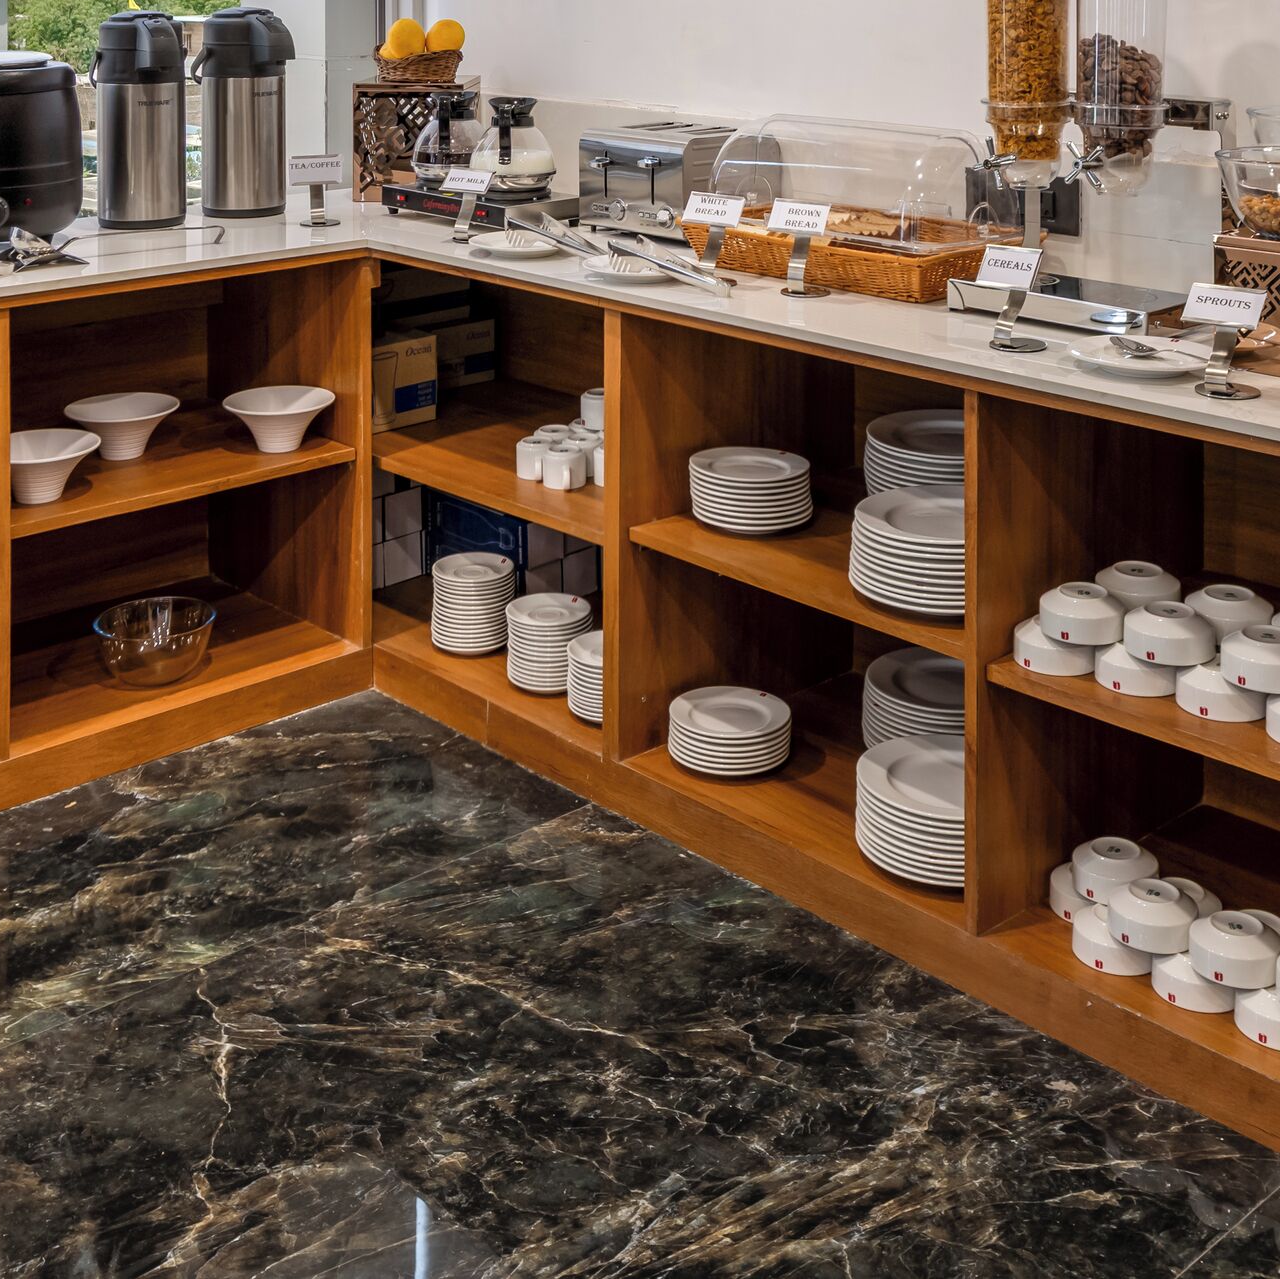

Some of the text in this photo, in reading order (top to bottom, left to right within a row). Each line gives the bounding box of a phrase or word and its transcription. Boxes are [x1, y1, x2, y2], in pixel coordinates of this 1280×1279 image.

[289, 160, 341, 170] TEA/COFFEE
[448, 176, 464, 184] HOT
[700, 196, 729, 207] WHITE
[694, 207, 728, 217] BREAD
[787, 207, 822, 219] BROWN
[784, 219, 819, 229] BREAD
[987, 257, 1033, 272] CEREALS
[1195, 295, 1252, 310] SPROUTS
[405, 344, 432, 357] Ocean
